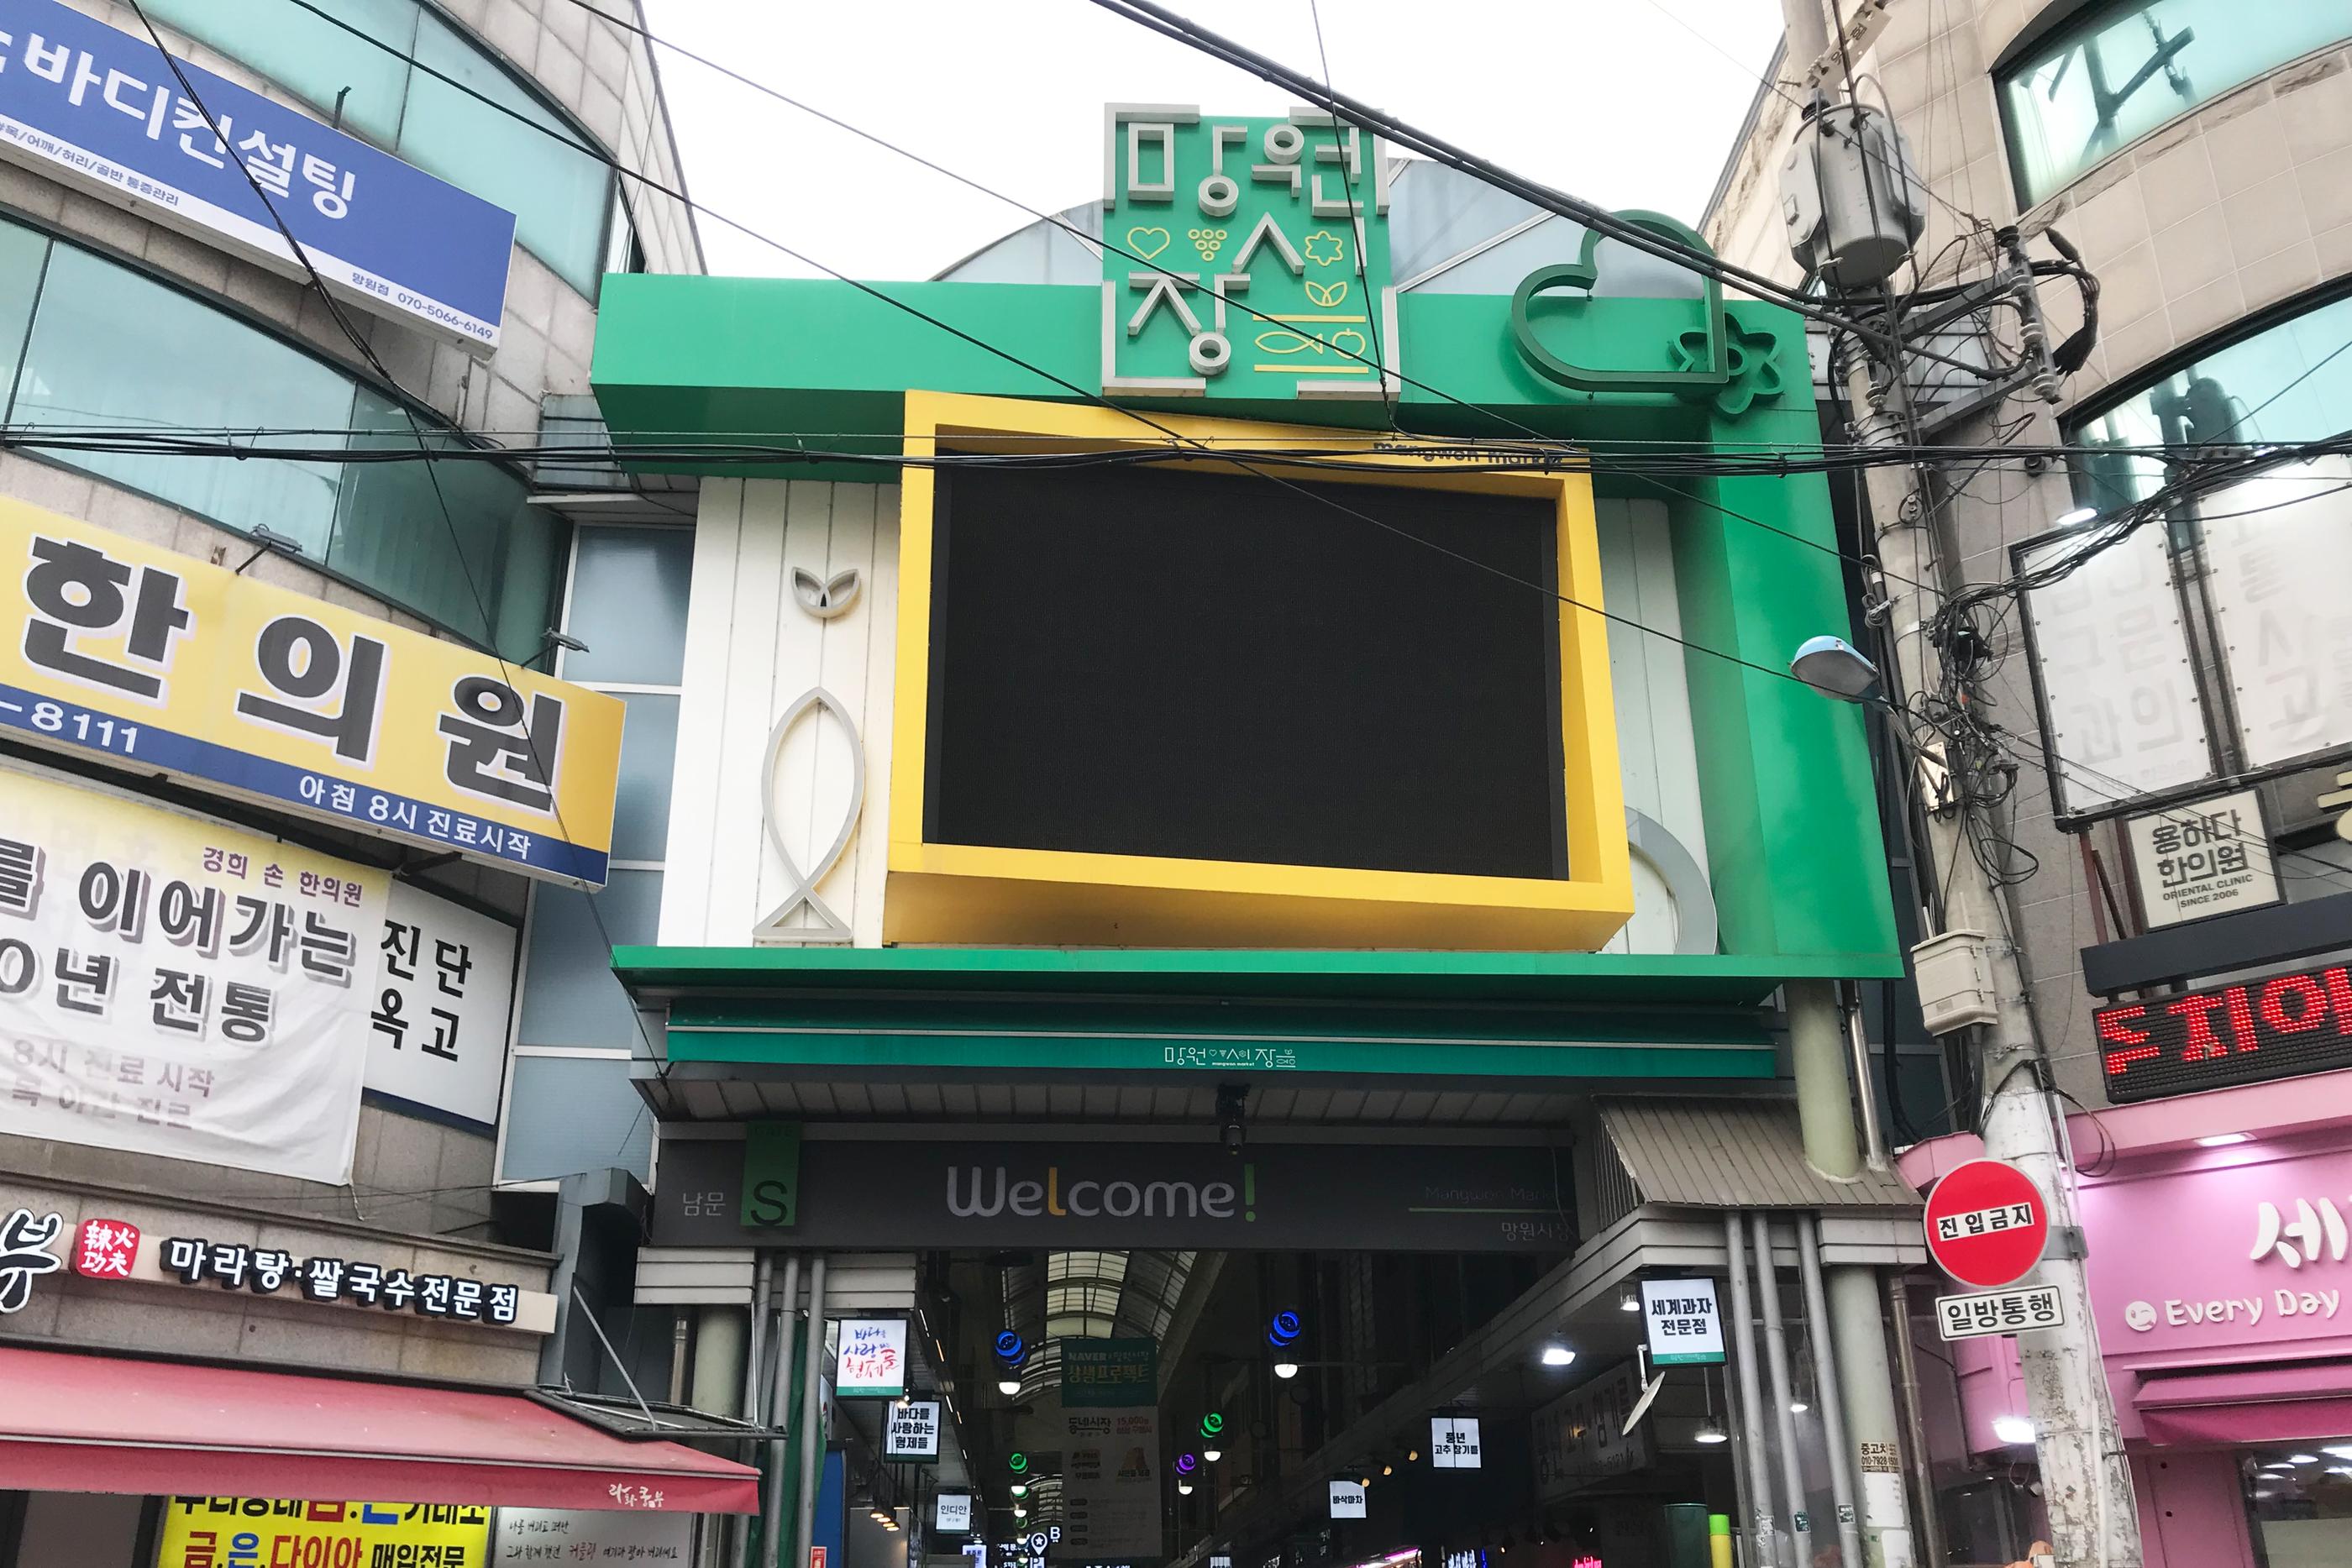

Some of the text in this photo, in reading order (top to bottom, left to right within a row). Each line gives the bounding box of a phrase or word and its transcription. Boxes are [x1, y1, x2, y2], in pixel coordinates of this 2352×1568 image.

[0, 30, 356, 219] 바디컨설팅
[127, 176, 179, 207] 통증관리
[352, 272, 493, 339] 망원점 070-5066-6149
[23, 536, 567, 813] 한의원
[299, 774, 532, 860] 아침 8시 진료시작
[2152, 810, 2241, 854] 용하다
[202, 845, 363, 908] 경희 손 한의원
[2157, 842, 2249, 889] 한의원
[2163, 874, 2253, 900] ORIENTAL CLINIC
[2181, 889, 2239, 908] SINCE 2006
[79, 861, 352, 983] 이어가는
[149, 967, 274, 1044] 전통
[14, 1038, 215, 1099] 8시 진료 시작
[682, 1191, 726, 1217] 남문
[749, 1180, 788, 1226] S
[946, 1162, 1257, 1224] Welcome!
[1939, 1204, 2034, 1239] 진입금지
[1651, 1298, 1713, 1316] 세계과자
[1947, 1292, 2055, 1331] 일방통행
[2164, 1288, 2341, 1327] Every Day
[1661, 1318, 1708, 1336] 전문점
[1068, 1351, 1107, 1361] NAVER
[891, 1422, 935, 1435] 사랑하는
[897, 1407, 931, 1421] 바다를
[895, 1436, 928, 1450] 형제들
[1446, 1432, 1466, 1445] 풍년
[941, 1504, 968, 1515] 인디안
